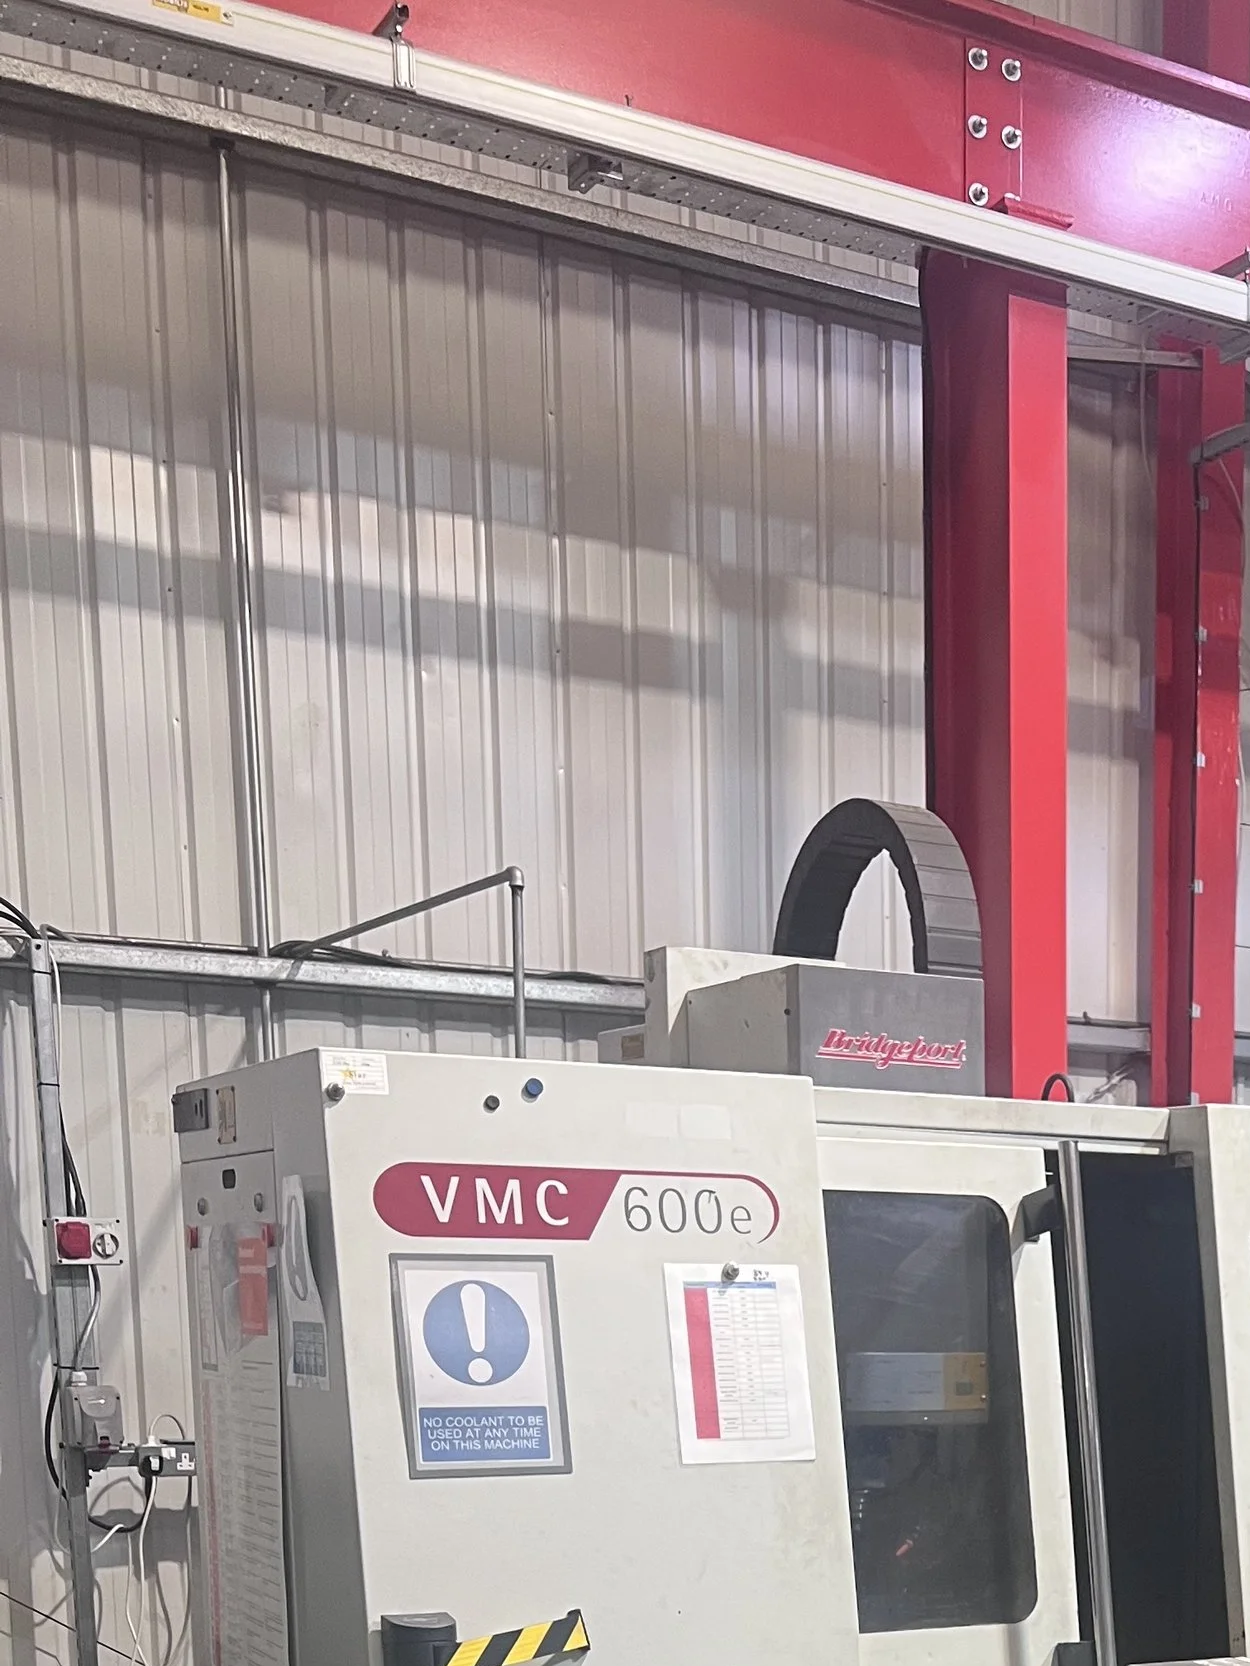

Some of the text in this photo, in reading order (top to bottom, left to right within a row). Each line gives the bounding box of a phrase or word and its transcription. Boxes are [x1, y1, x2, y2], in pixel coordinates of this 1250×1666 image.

[817, 1028, 966, 1069] Bridgeport
[420, 1174, 752, 1234] VMC 600e
[423, 1415, 544, 1428] NO COOLANT TO BE
[427, 1427, 541, 1440] USED AT ANY TIME
[431, 1438, 540, 1451] ON THIS MACHINE
